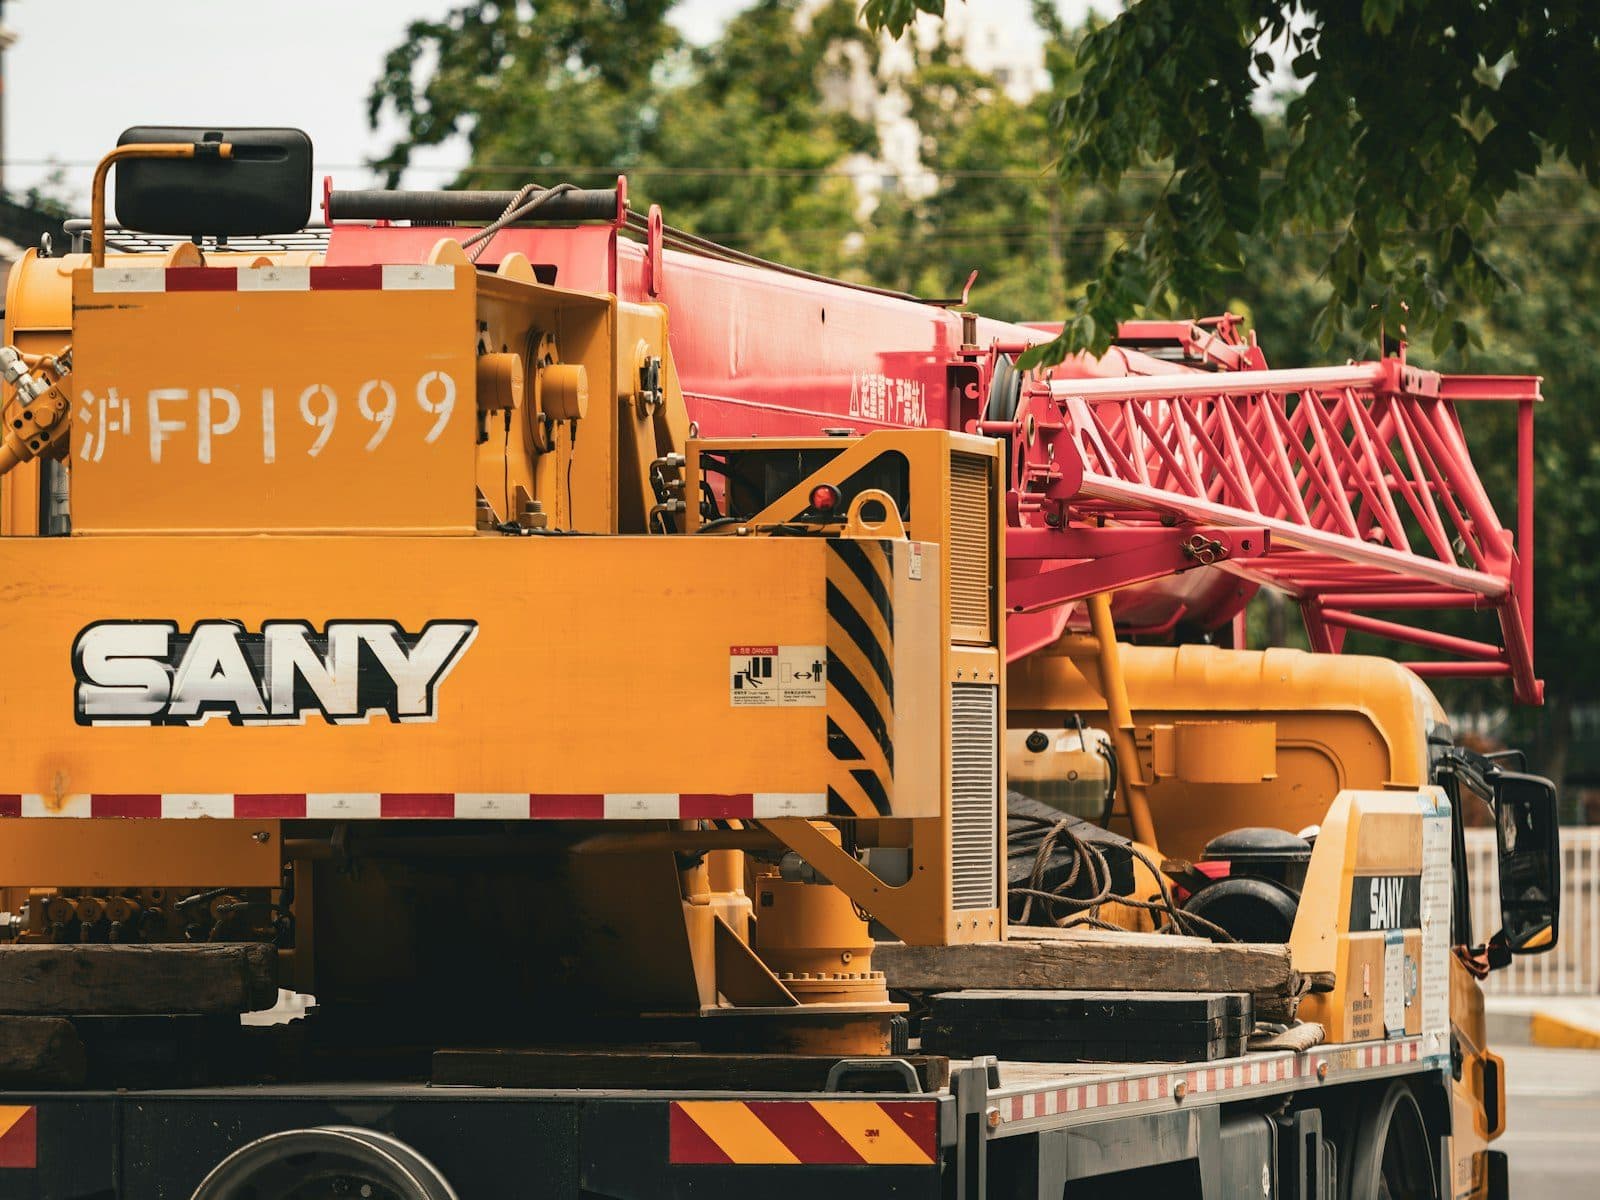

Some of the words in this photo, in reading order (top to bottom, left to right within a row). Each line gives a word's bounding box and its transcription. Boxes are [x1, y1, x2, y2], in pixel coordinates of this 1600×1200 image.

[76, 620, 478, 724] SANY
[1369, 877, 1404, 930] SANY
[864, 1129, 880, 1137] 3M
